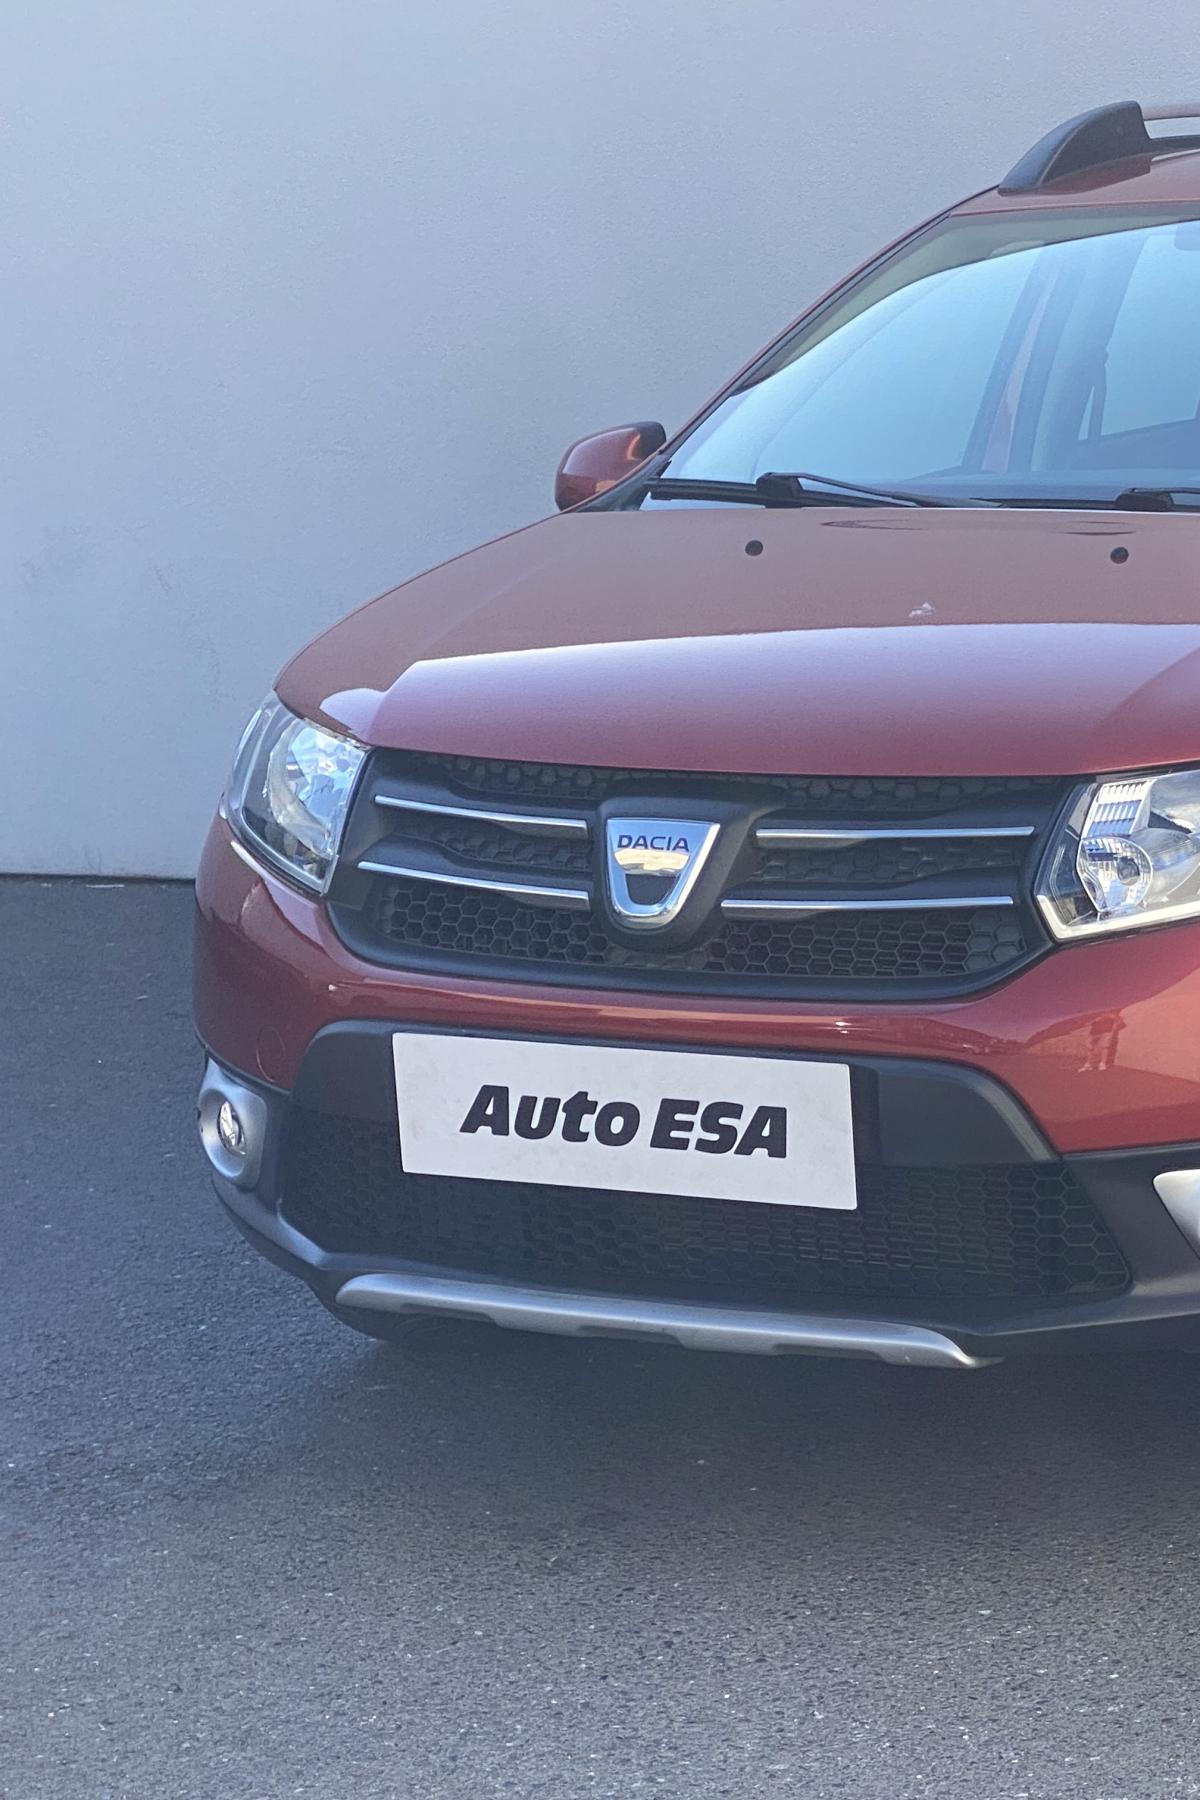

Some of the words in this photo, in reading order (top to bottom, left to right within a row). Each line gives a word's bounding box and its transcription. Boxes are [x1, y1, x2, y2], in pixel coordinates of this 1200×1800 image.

[617, 834, 690, 852] DACIA
[460, 1085, 641, 1147] Auto
[650, 1097, 788, 1159] ESA
